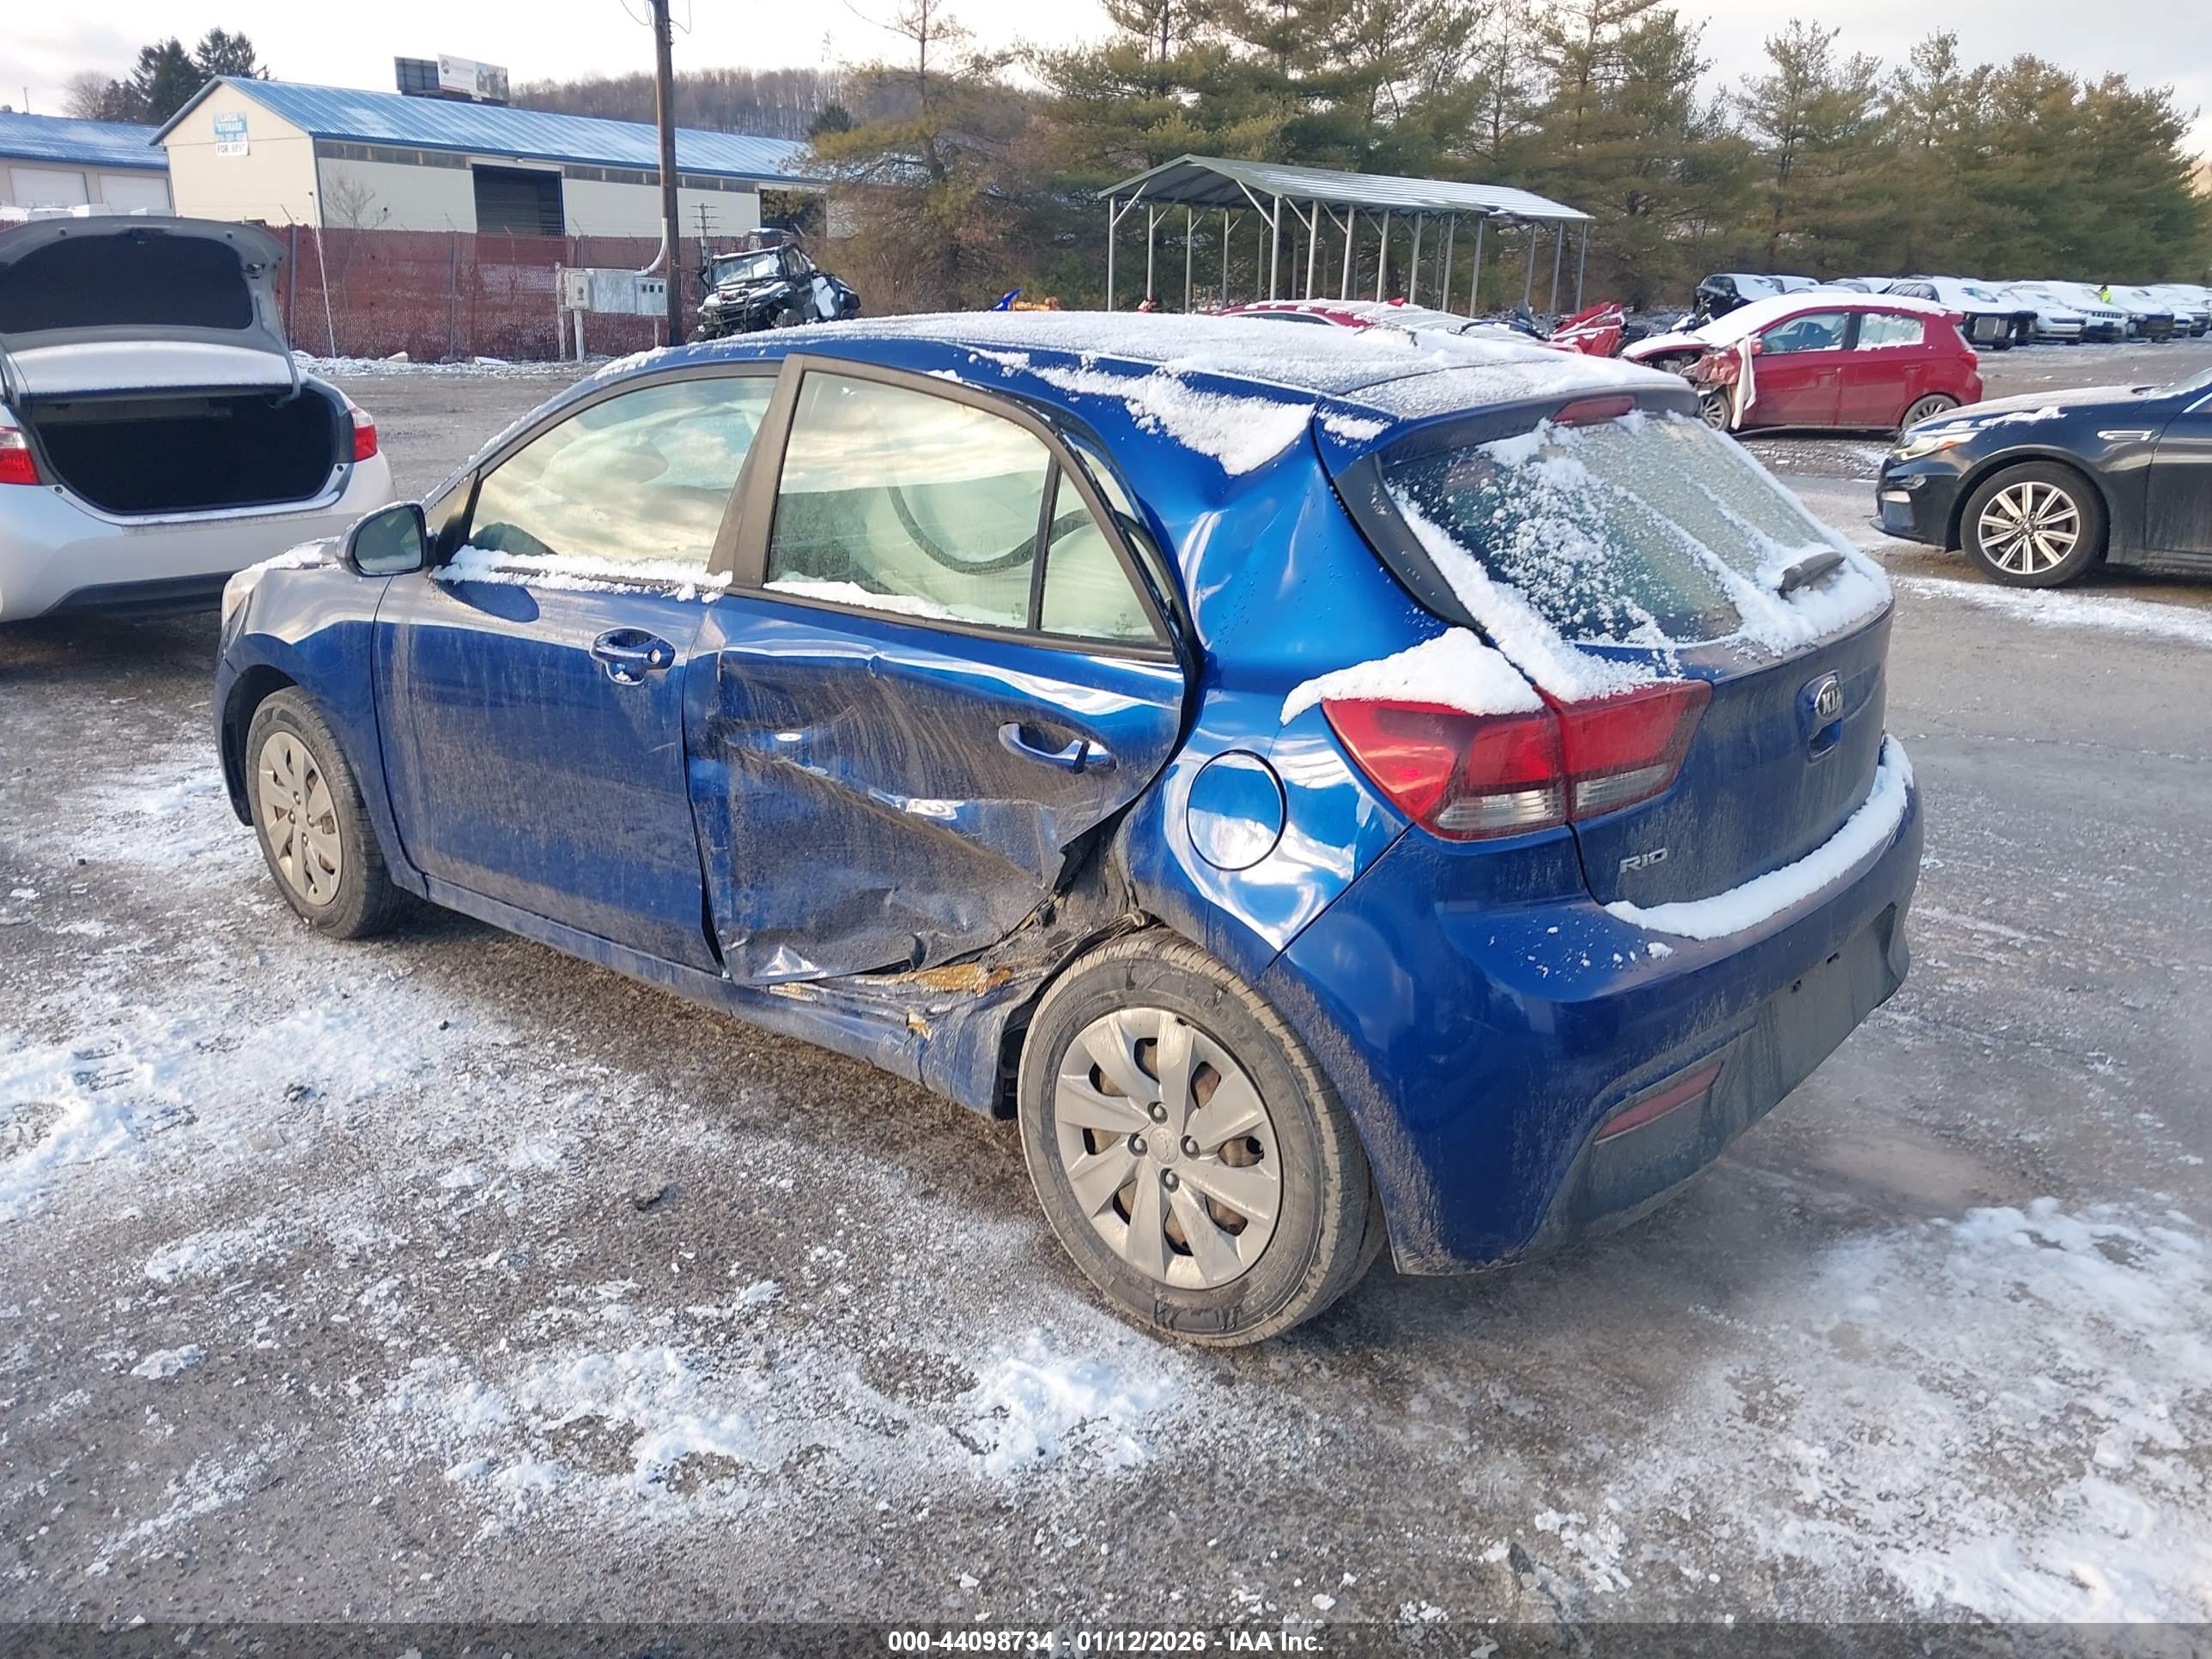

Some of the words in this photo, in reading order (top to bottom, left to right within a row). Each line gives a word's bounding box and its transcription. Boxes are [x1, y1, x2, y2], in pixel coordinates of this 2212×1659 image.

[217, 122, 243, 132] STORAGE
[217, 143, 228, 153] FOR
[232, 143, 246, 153] RENT
[1821, 686, 1842, 715] KIA
